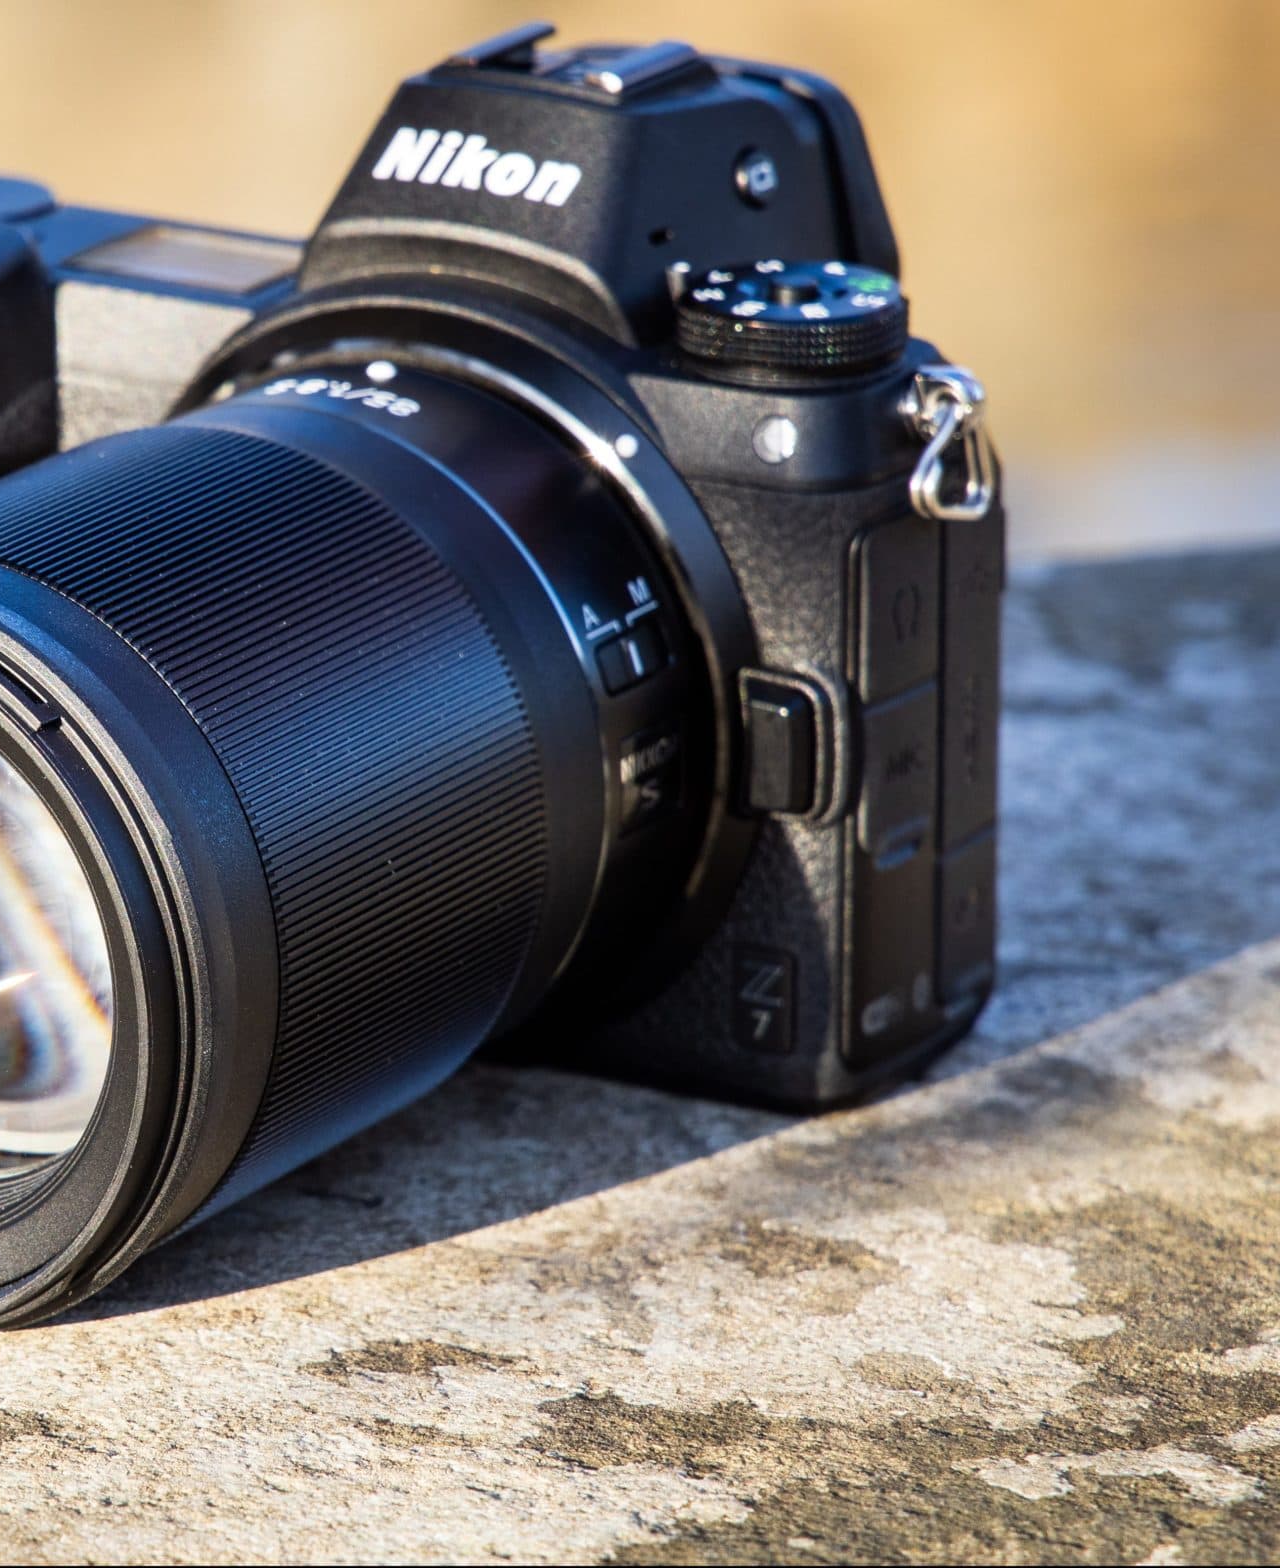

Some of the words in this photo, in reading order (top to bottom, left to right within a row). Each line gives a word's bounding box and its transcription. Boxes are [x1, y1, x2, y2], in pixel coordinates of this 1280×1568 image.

[371, 126, 582, 207] Nikon
[626, 575, 652, 604] M
[581, 602, 601, 630] A
[738, 959, 784, 1008] Z
[750, 1009, 774, 1041] 7
